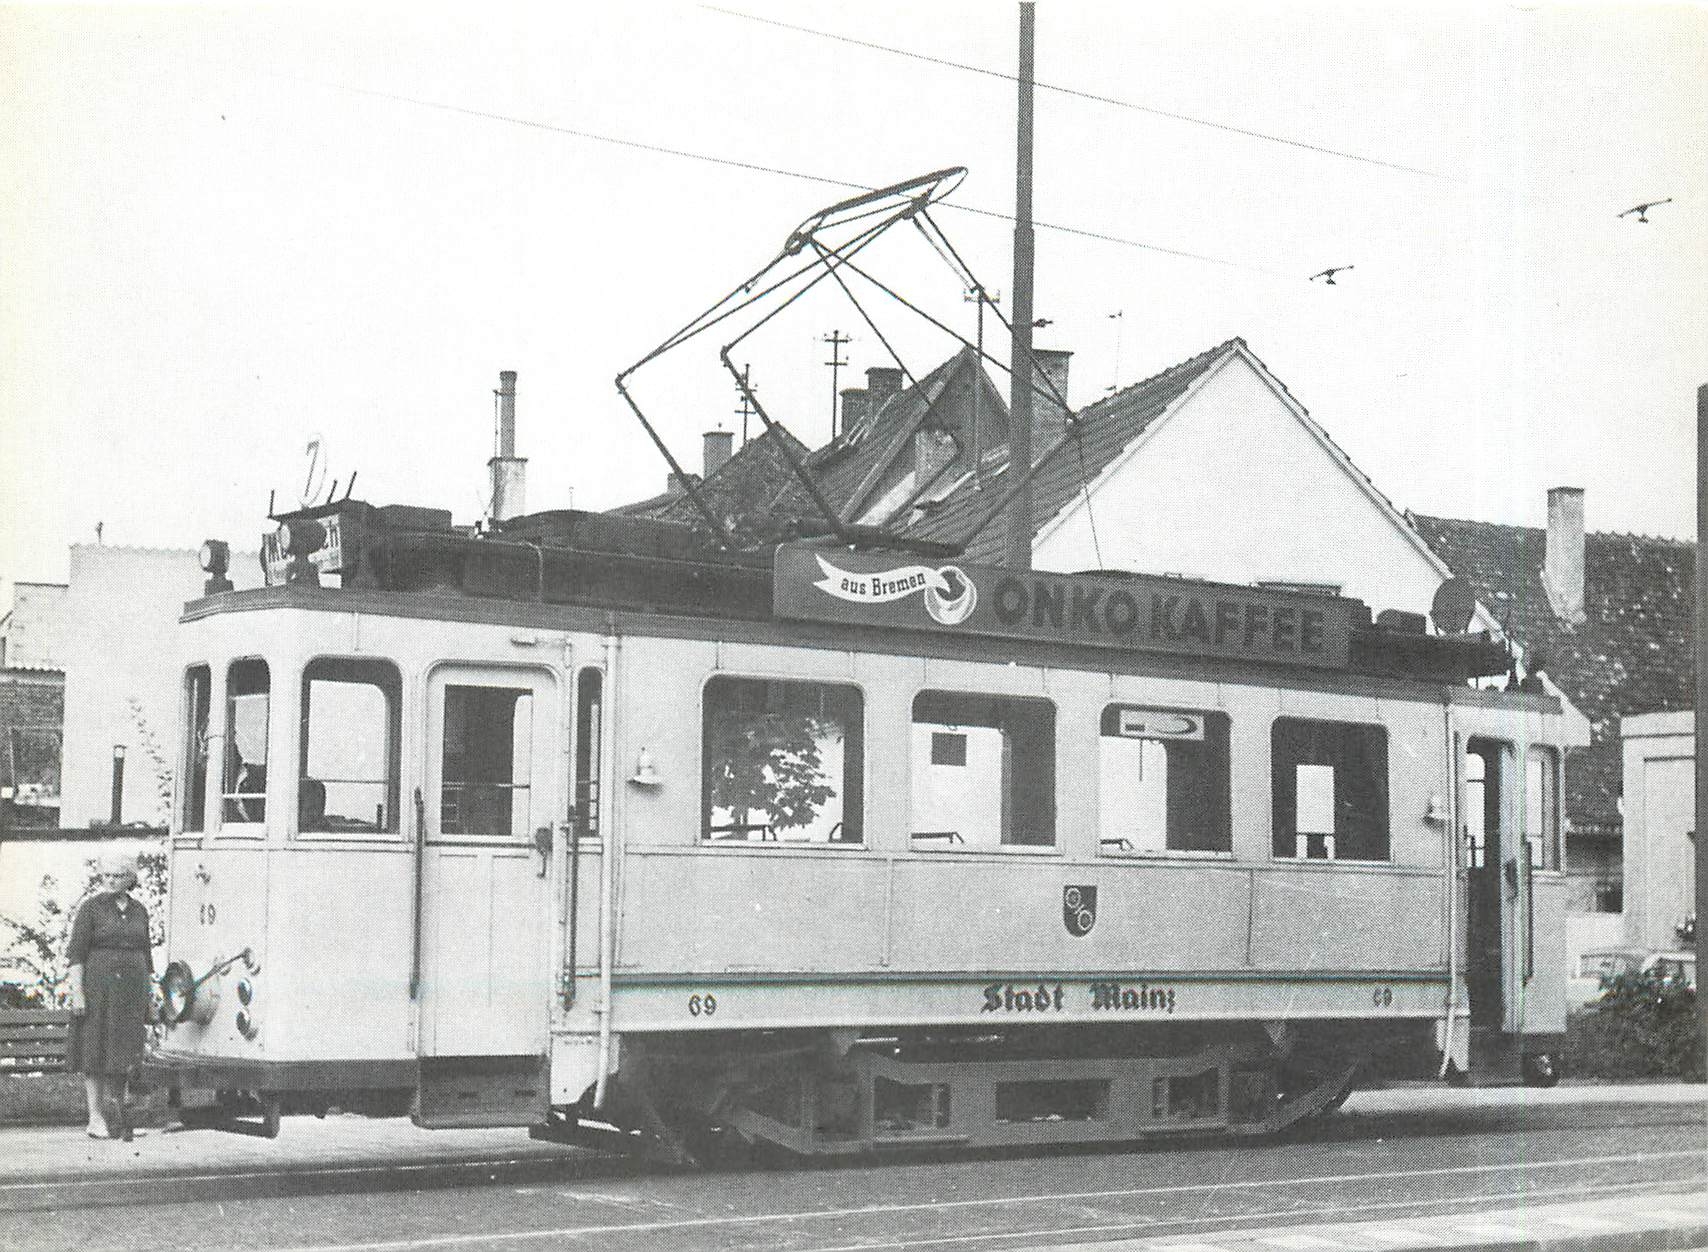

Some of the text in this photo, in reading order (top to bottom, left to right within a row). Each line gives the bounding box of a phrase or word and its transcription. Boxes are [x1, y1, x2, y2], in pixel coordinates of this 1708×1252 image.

[840, 572, 926, 597] aus Bremen
[995, 576, 1324, 651] ONKO KAFFEE
[688, 993, 718, 1017] 69
[980, 982, 1176, 1015] Stadt Mainz
